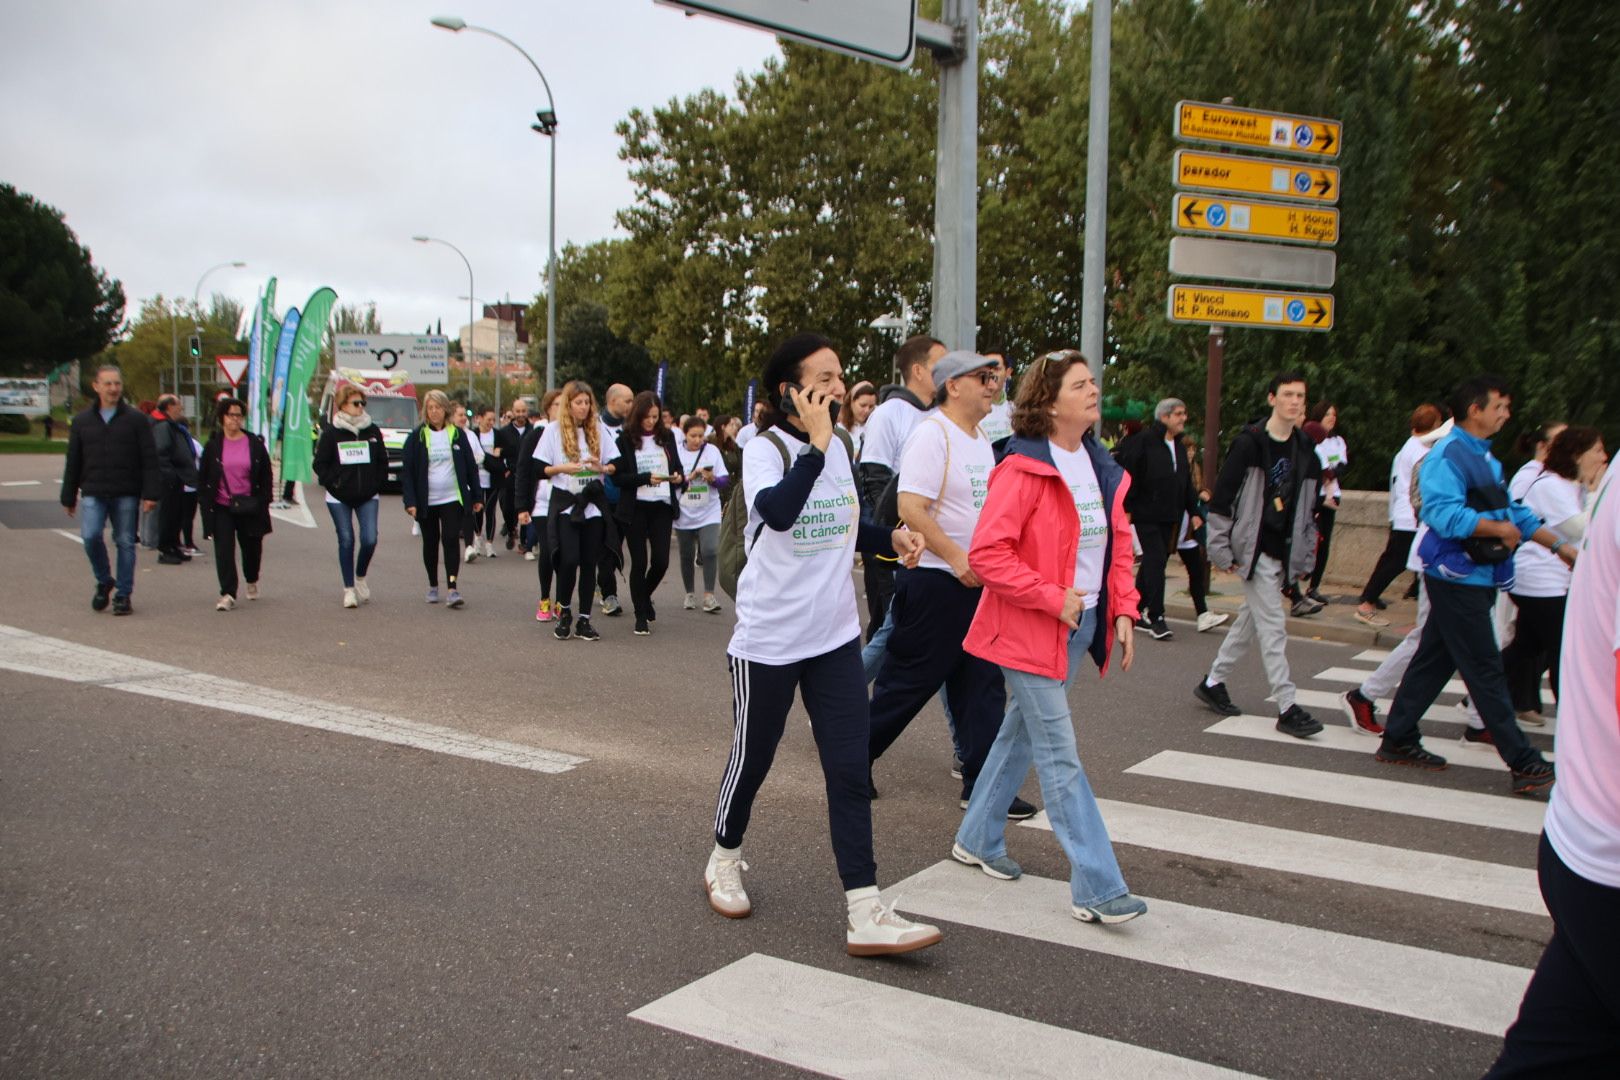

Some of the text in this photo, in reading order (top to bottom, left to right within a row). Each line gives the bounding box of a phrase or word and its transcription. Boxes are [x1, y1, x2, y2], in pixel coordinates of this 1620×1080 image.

[1203, 110, 1257, 127] Eurowest
[1183, 165, 1231, 177] parador
[1304, 224, 1333, 240] Regio
[1193, 292, 1224, 304] Vincci
[1207, 305, 1250, 319] Romano
[813, 494, 855, 510] marcha
[792, 523, 851, 539] el cáncer
